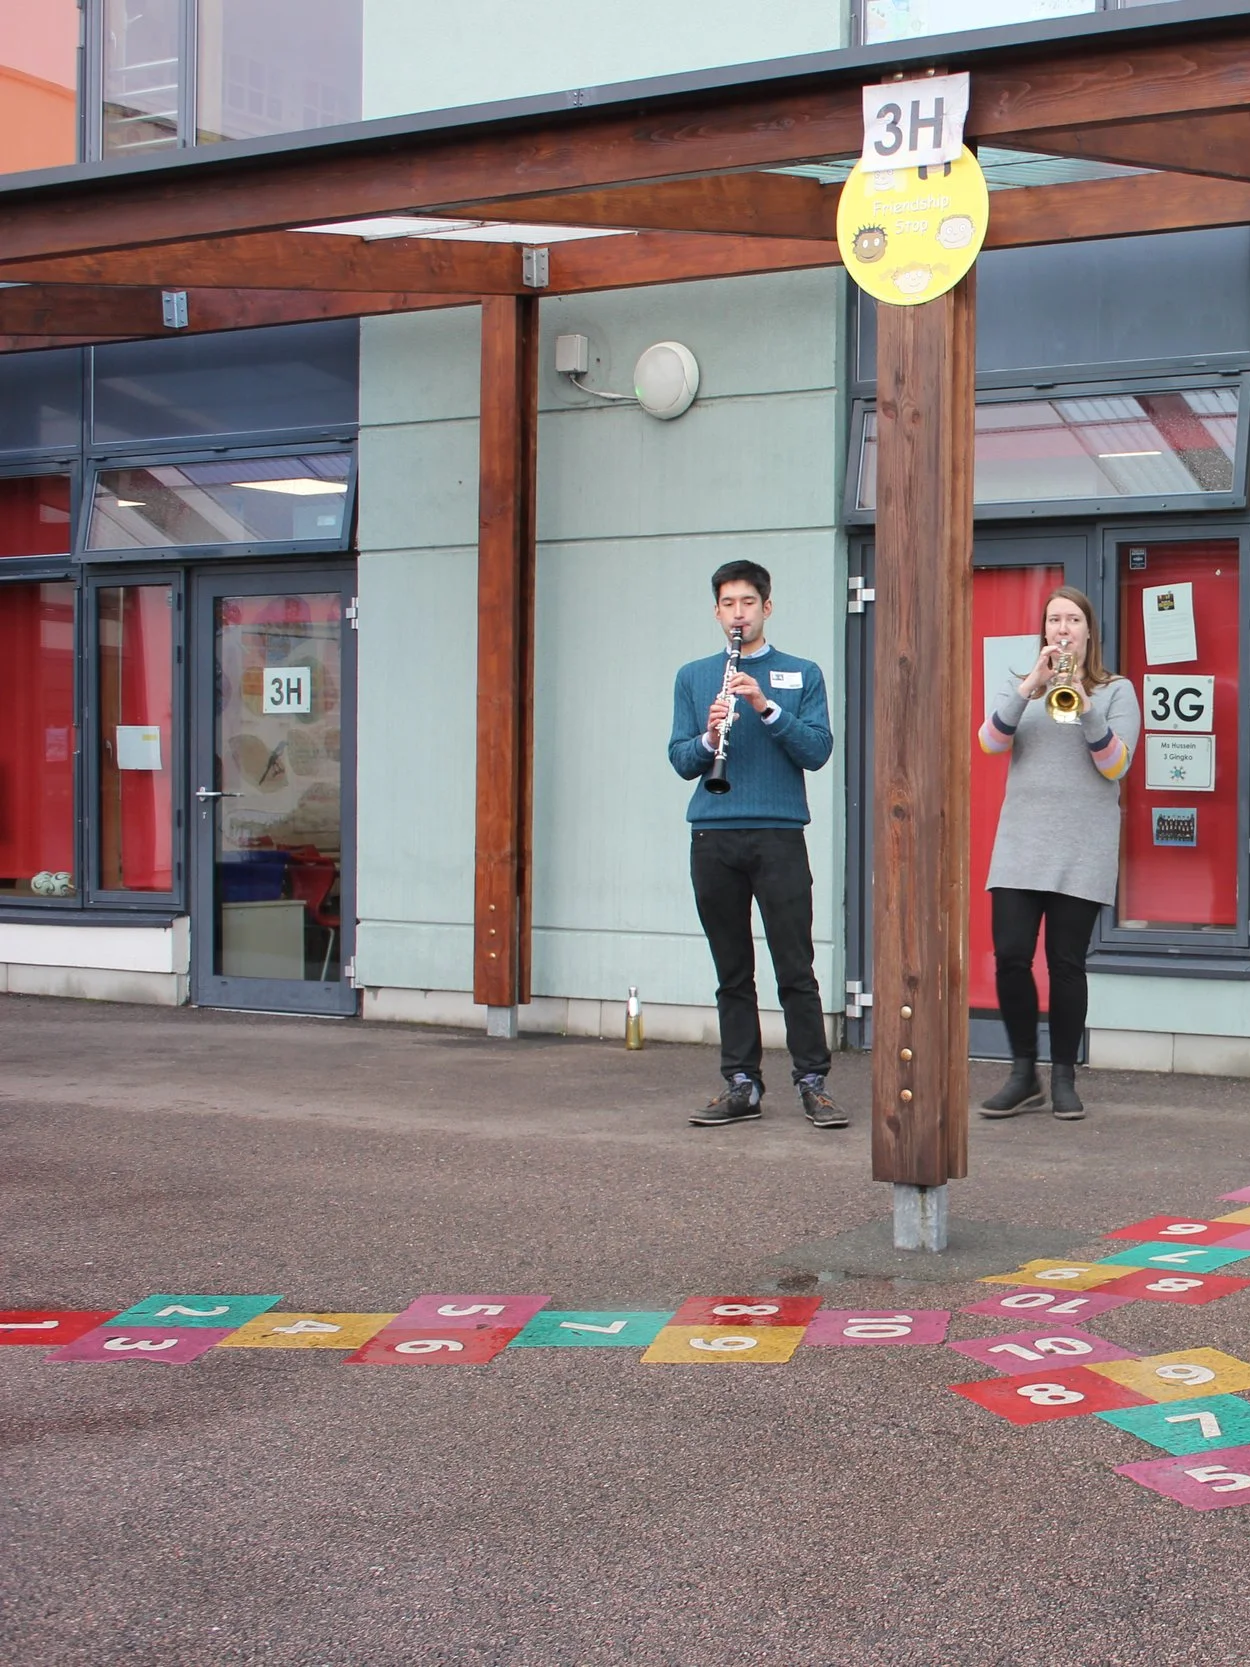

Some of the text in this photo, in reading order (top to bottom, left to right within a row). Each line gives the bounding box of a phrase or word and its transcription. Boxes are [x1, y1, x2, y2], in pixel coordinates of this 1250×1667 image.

[873, 97, 945, 156] 3H
[872, 194, 950, 217] Friendship
[894, 218, 929, 236] Stop
[270, 677, 302, 706] 3H
[1151, 686, 1204, 722] 3G
[1168, 753, 1193, 761] Gingko
[1148, 1250, 1209, 1264] 7
[1145, 1277, 1204, 1292] 8
[154, 1305, 230, 1317] 2
[437, 1304, 506, 1317] 5
[713, 1304, 780, 1316] 8
[1000, 1293, 1090, 1315] 10
[273, 1319, 342, 1334] 4
[560, 1320, 628, 1334] 7
[843, 1315, 914, 1339] 10
[103, 1337, 179, 1351] 3
[988, 1337, 1094, 1360] 10
[1154, 1363, 1216, 1386] 9
[1016, 1383, 1085, 1405] 8
[1165, 1411, 1222, 1439] 7
